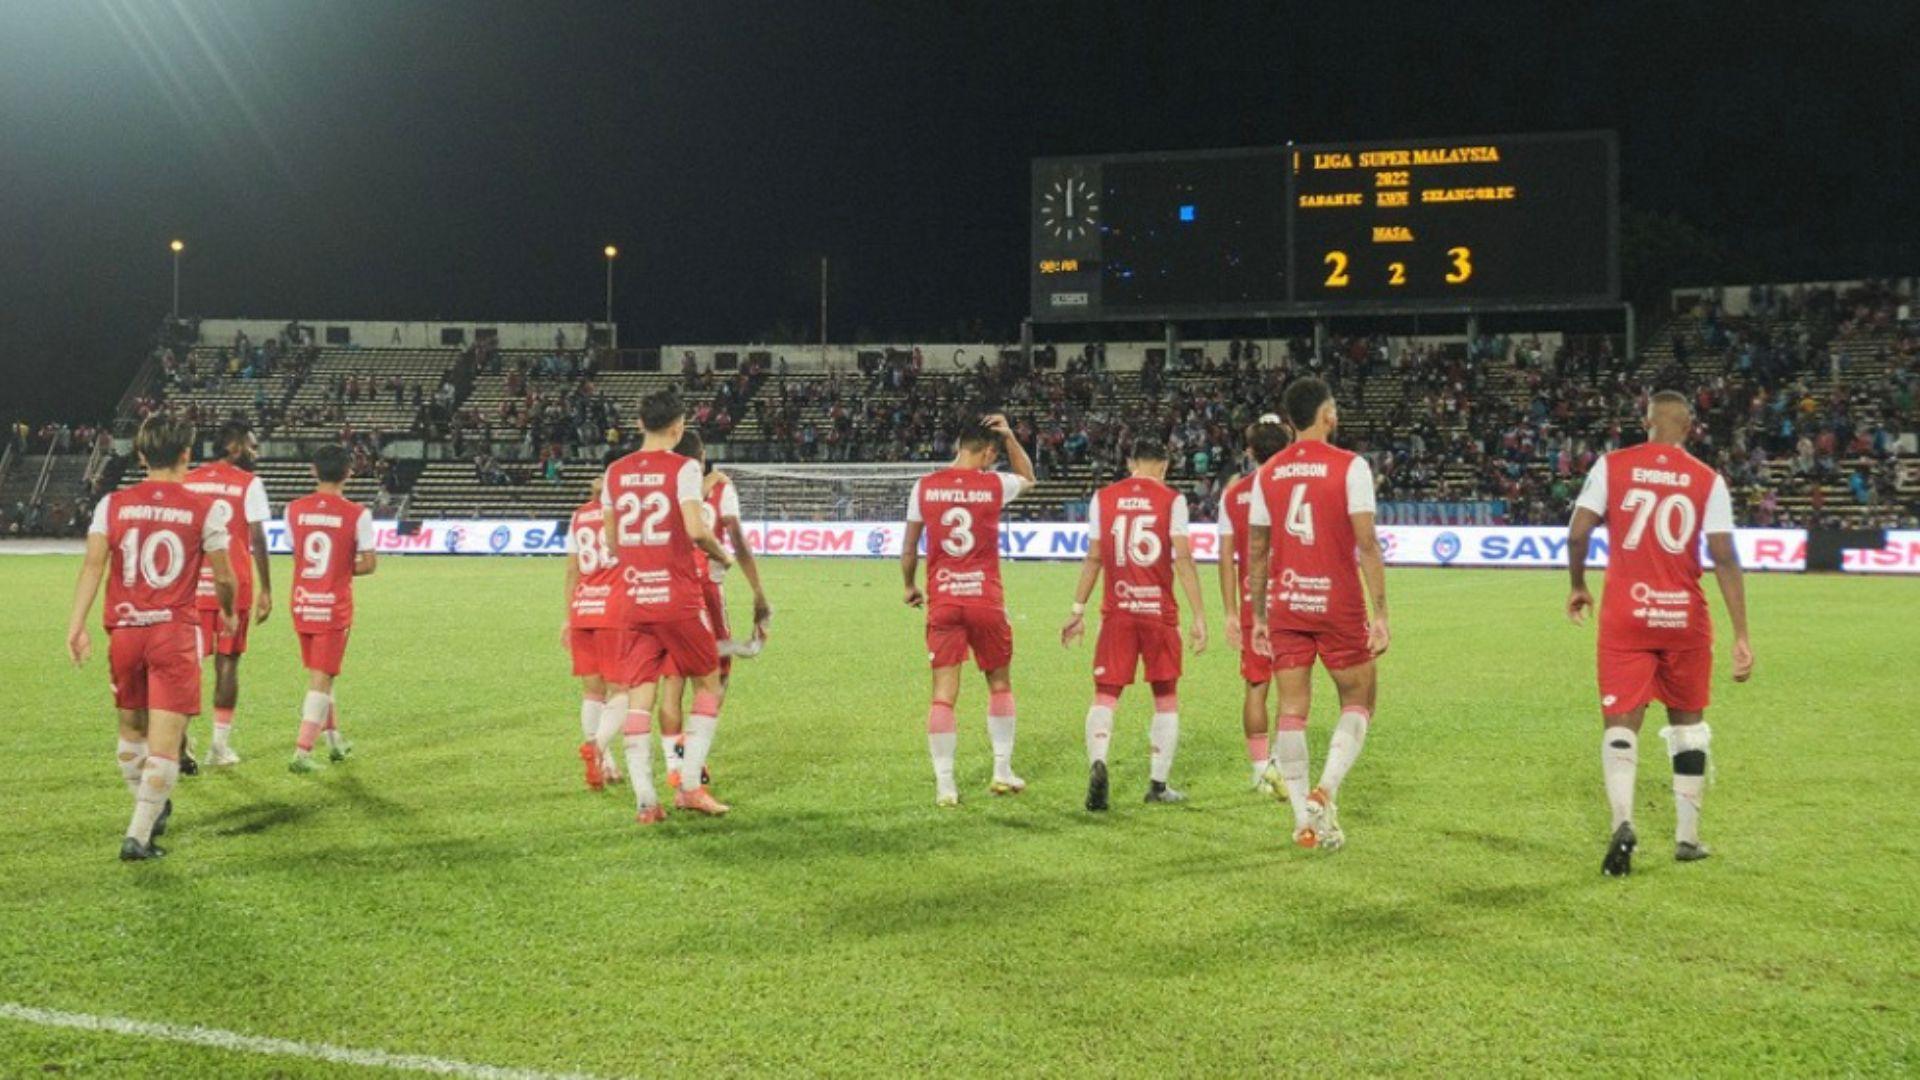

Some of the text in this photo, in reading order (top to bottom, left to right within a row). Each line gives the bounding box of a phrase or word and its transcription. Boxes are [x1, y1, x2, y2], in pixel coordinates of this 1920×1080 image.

[1314, 147, 1499, 169] LIGA SUPER MALAYSIA
[1375, 172, 1409, 187] 2022
[1324, 246, 1472, 286] 2 2 3
[616, 492, 671, 546] 22
[941, 506, 976, 557] 3
[1285, 483, 1314, 545] 4
[1621, 487, 1696, 554] 70
[120, 527, 184, 589] 10
[301, 530, 332, 579] 9
[1110, 514, 1162, 567] 16
